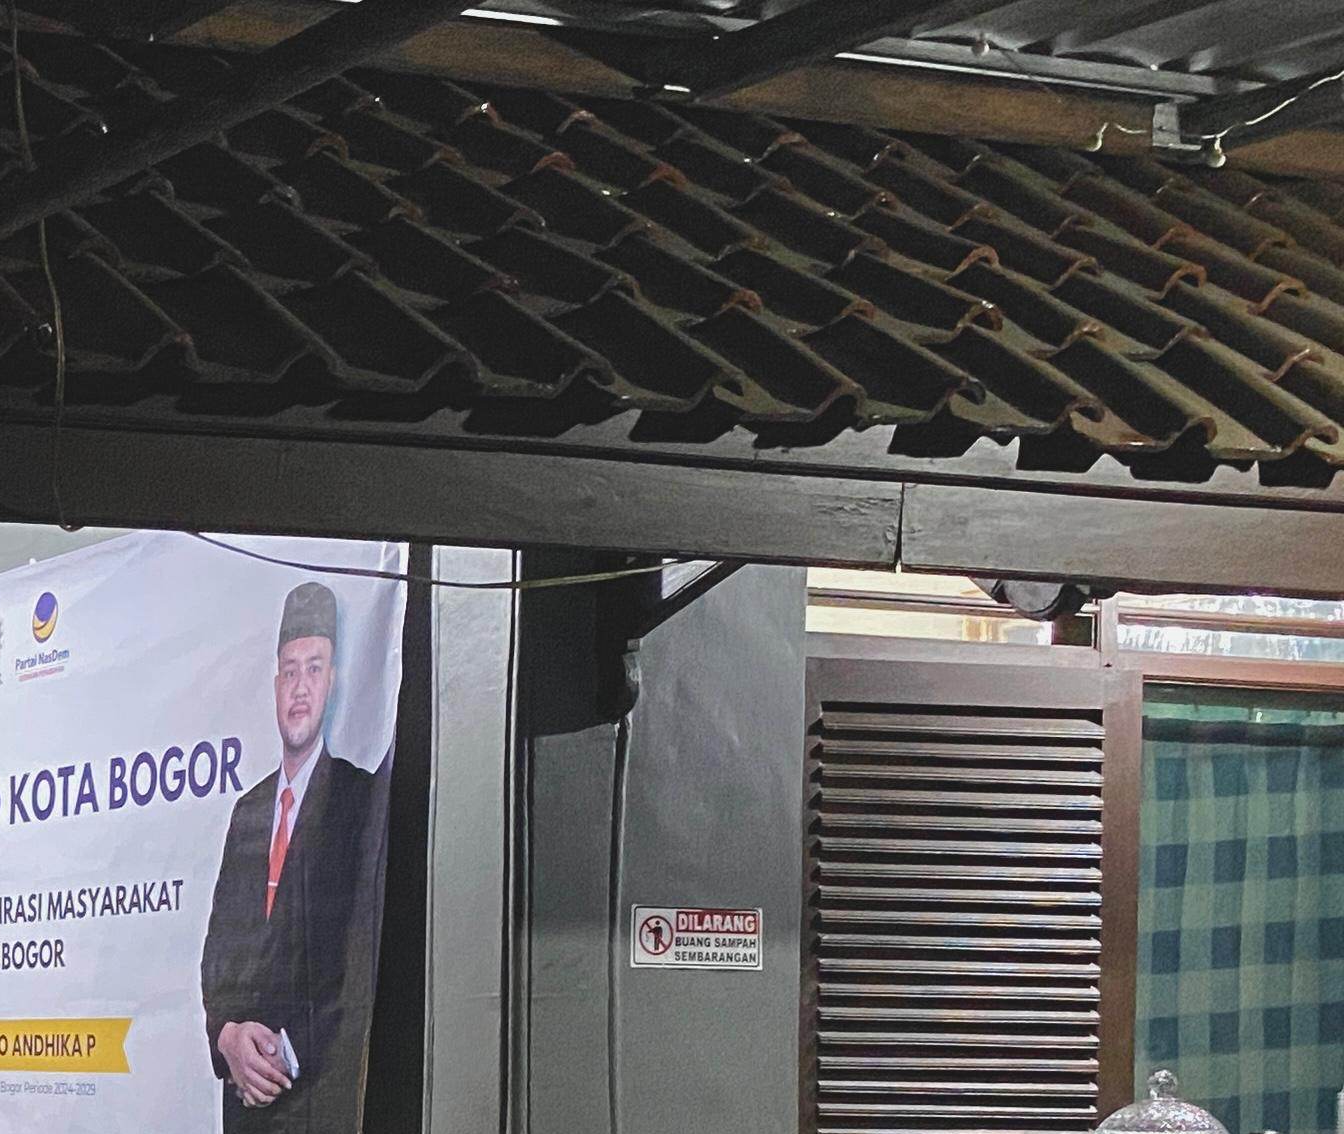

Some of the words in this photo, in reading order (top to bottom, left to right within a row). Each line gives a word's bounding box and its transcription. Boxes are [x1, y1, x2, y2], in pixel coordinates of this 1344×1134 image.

[15, 655, 37, 670] Partai
[38, 649, 70, 666] NasDem
[9, 762, 99, 825] KOTA
[109, 737, 243, 810] BOGOR
[47, 880, 184, 920] MASYARAKAT
[677, 912, 755, 933] DILARANG
[675, 936, 711, 948] BUANG
[714, 938, 756, 949] SAMPAH
[1, 939, 65, 970] BOGOR
[674, 951, 756, 963] SEMBARANGAN
[12, 1034, 82, 1057] ANDHIKA
[86, 1034, 96, 1057] P
